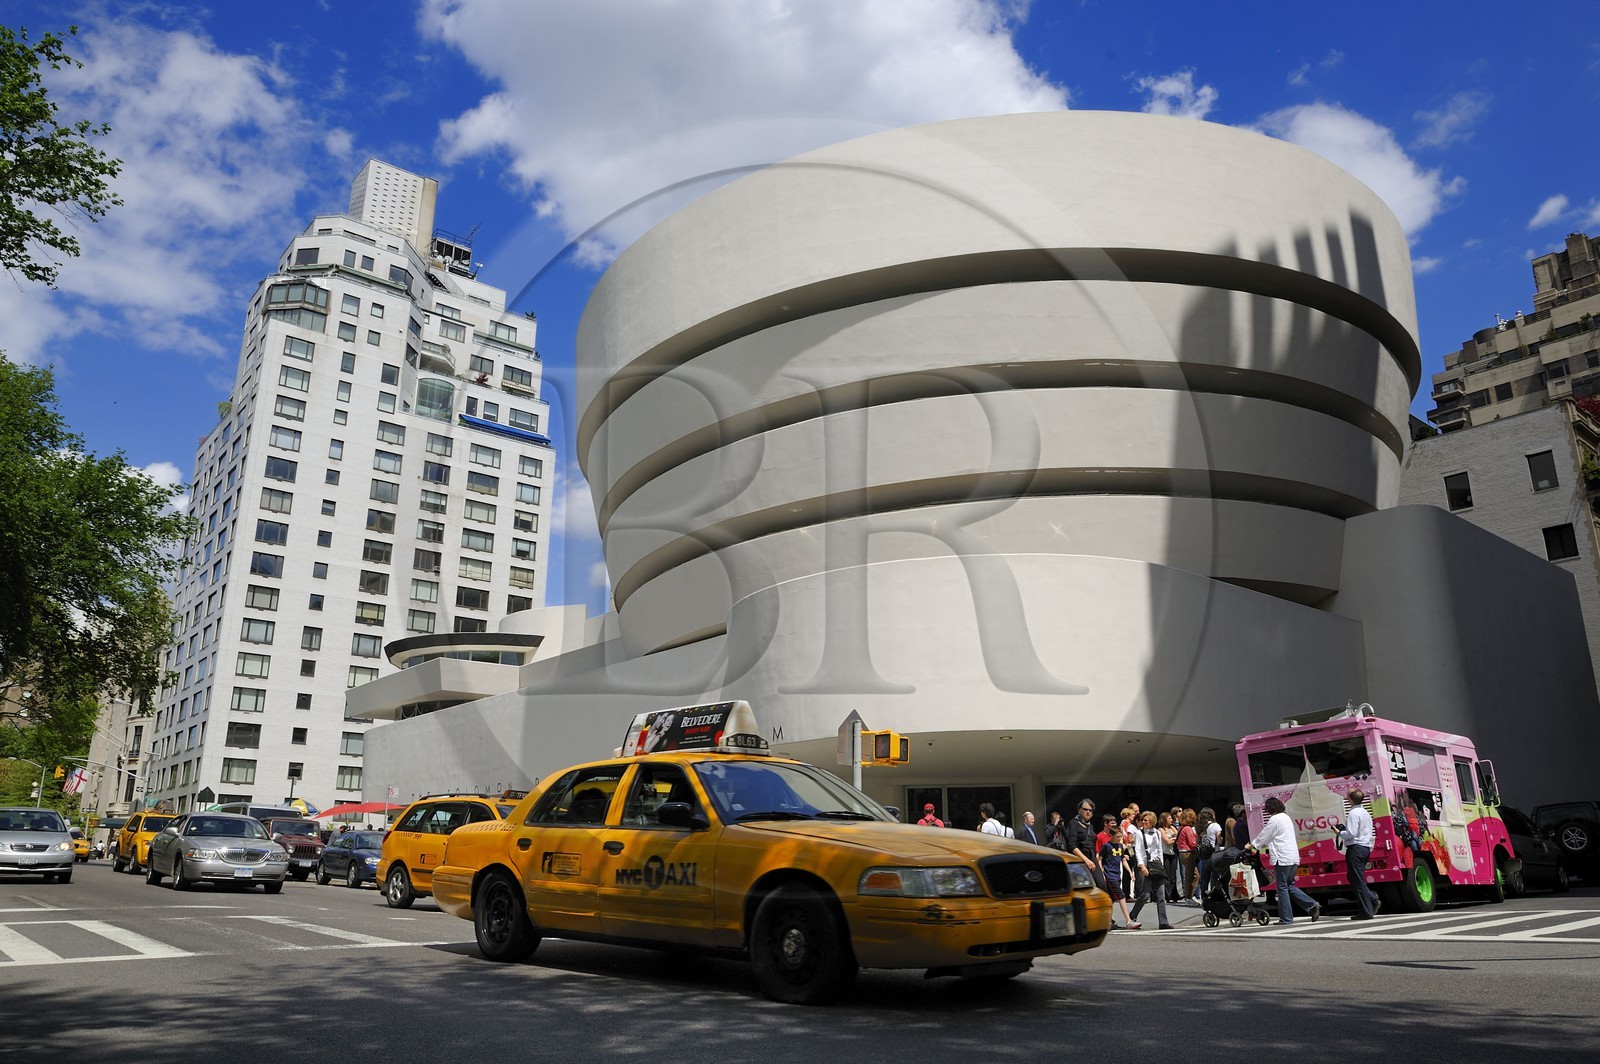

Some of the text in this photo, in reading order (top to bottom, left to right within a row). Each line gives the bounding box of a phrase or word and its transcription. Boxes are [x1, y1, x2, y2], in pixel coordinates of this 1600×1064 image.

[681, 713, 723, 728] BELVEDERE
[736, 735, 757, 747] 8L63
[1295, 815, 1339, 831] YOGO
[615, 857, 697, 887] NYC TAXI
